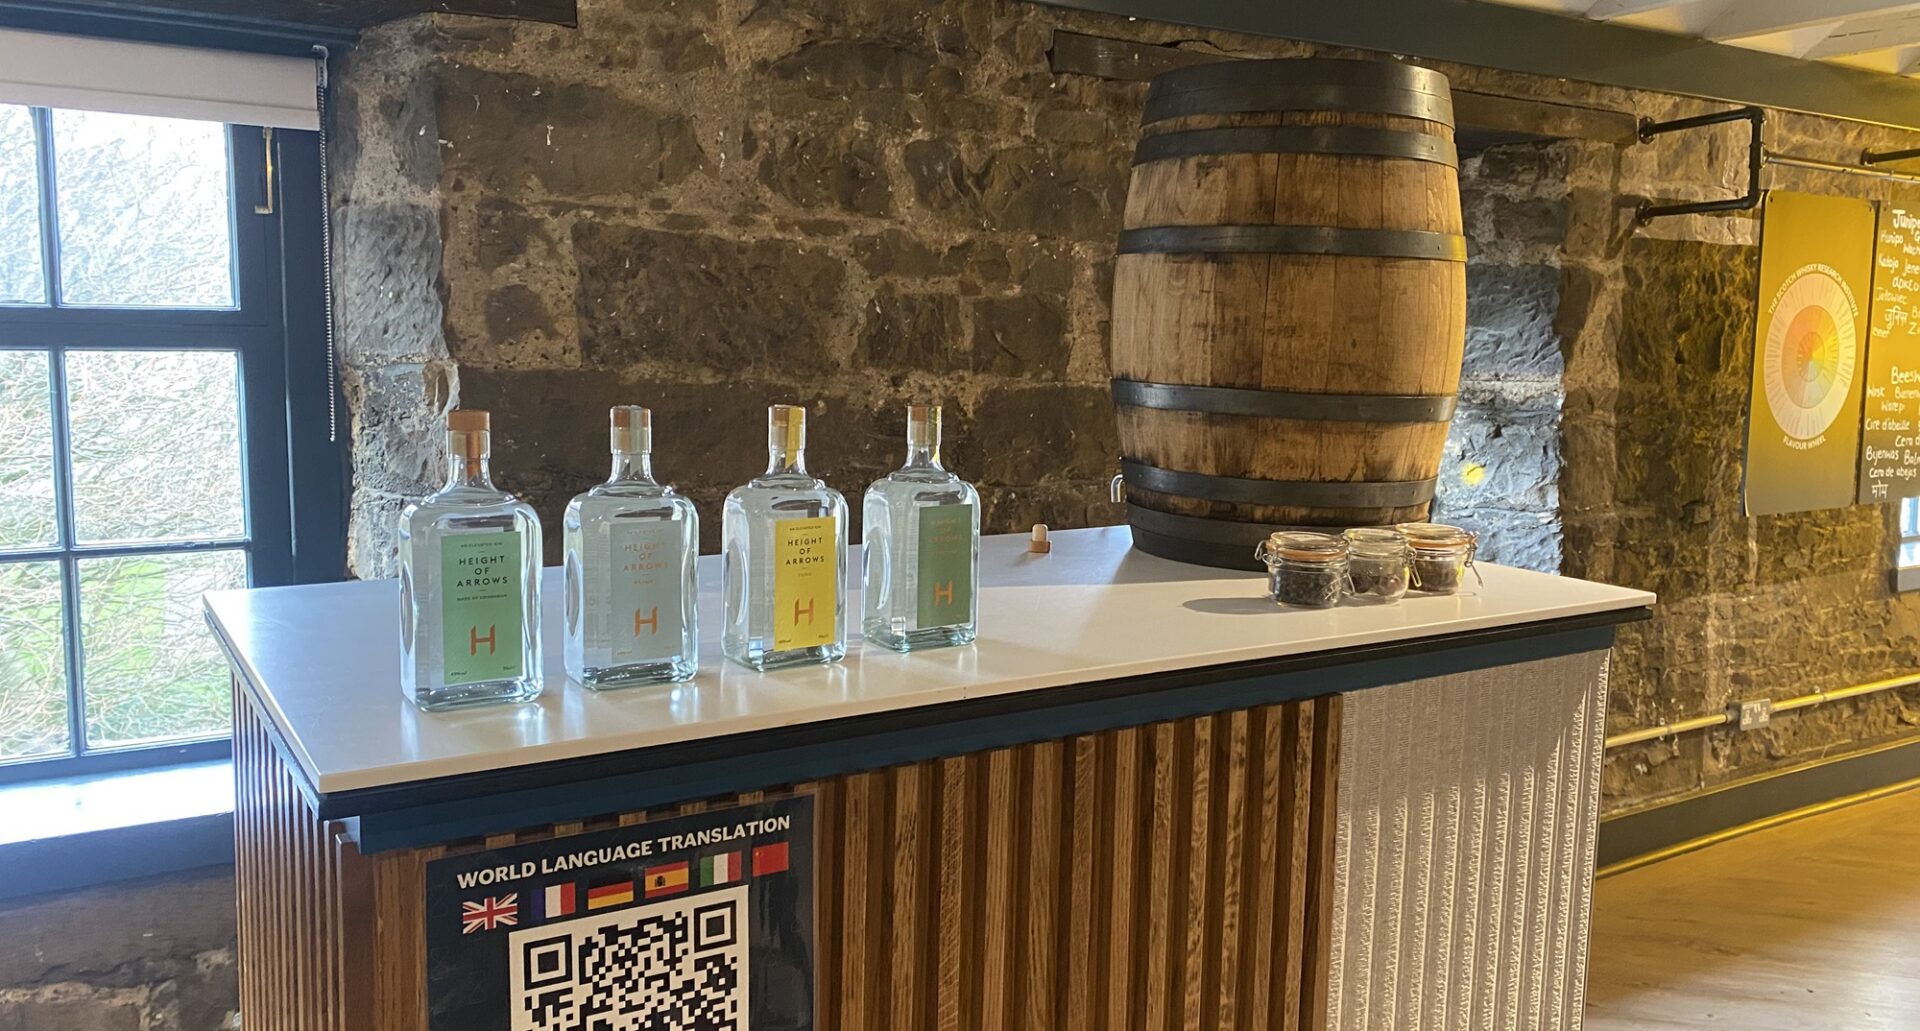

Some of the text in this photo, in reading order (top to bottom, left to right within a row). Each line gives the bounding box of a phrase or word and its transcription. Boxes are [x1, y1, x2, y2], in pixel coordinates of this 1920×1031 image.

[1768, 263, 1859, 317] THE SCOTCH WHISKY RESEARCH INSTITUTE
[1783, 434, 1827, 450] FLAVOUR WHEEL
[787, 537, 823, 547] HEIGHT
[639, 552, 653, 561] OF
[799, 547, 811, 555] OF
[459, 555, 505, 566] HEIGHT
[785, 555, 825, 566] ARROWS
[474, 566, 490, 576] OF
[456, 576, 508, 588] ARROWS
[933, 579, 954, 606] H
[794, 597, 815, 627] H
[634, 606, 658, 638] H
[470, 624, 496, 657] H
[457, 815, 791, 890] WORLD LANGUAGE TRANSLATION
